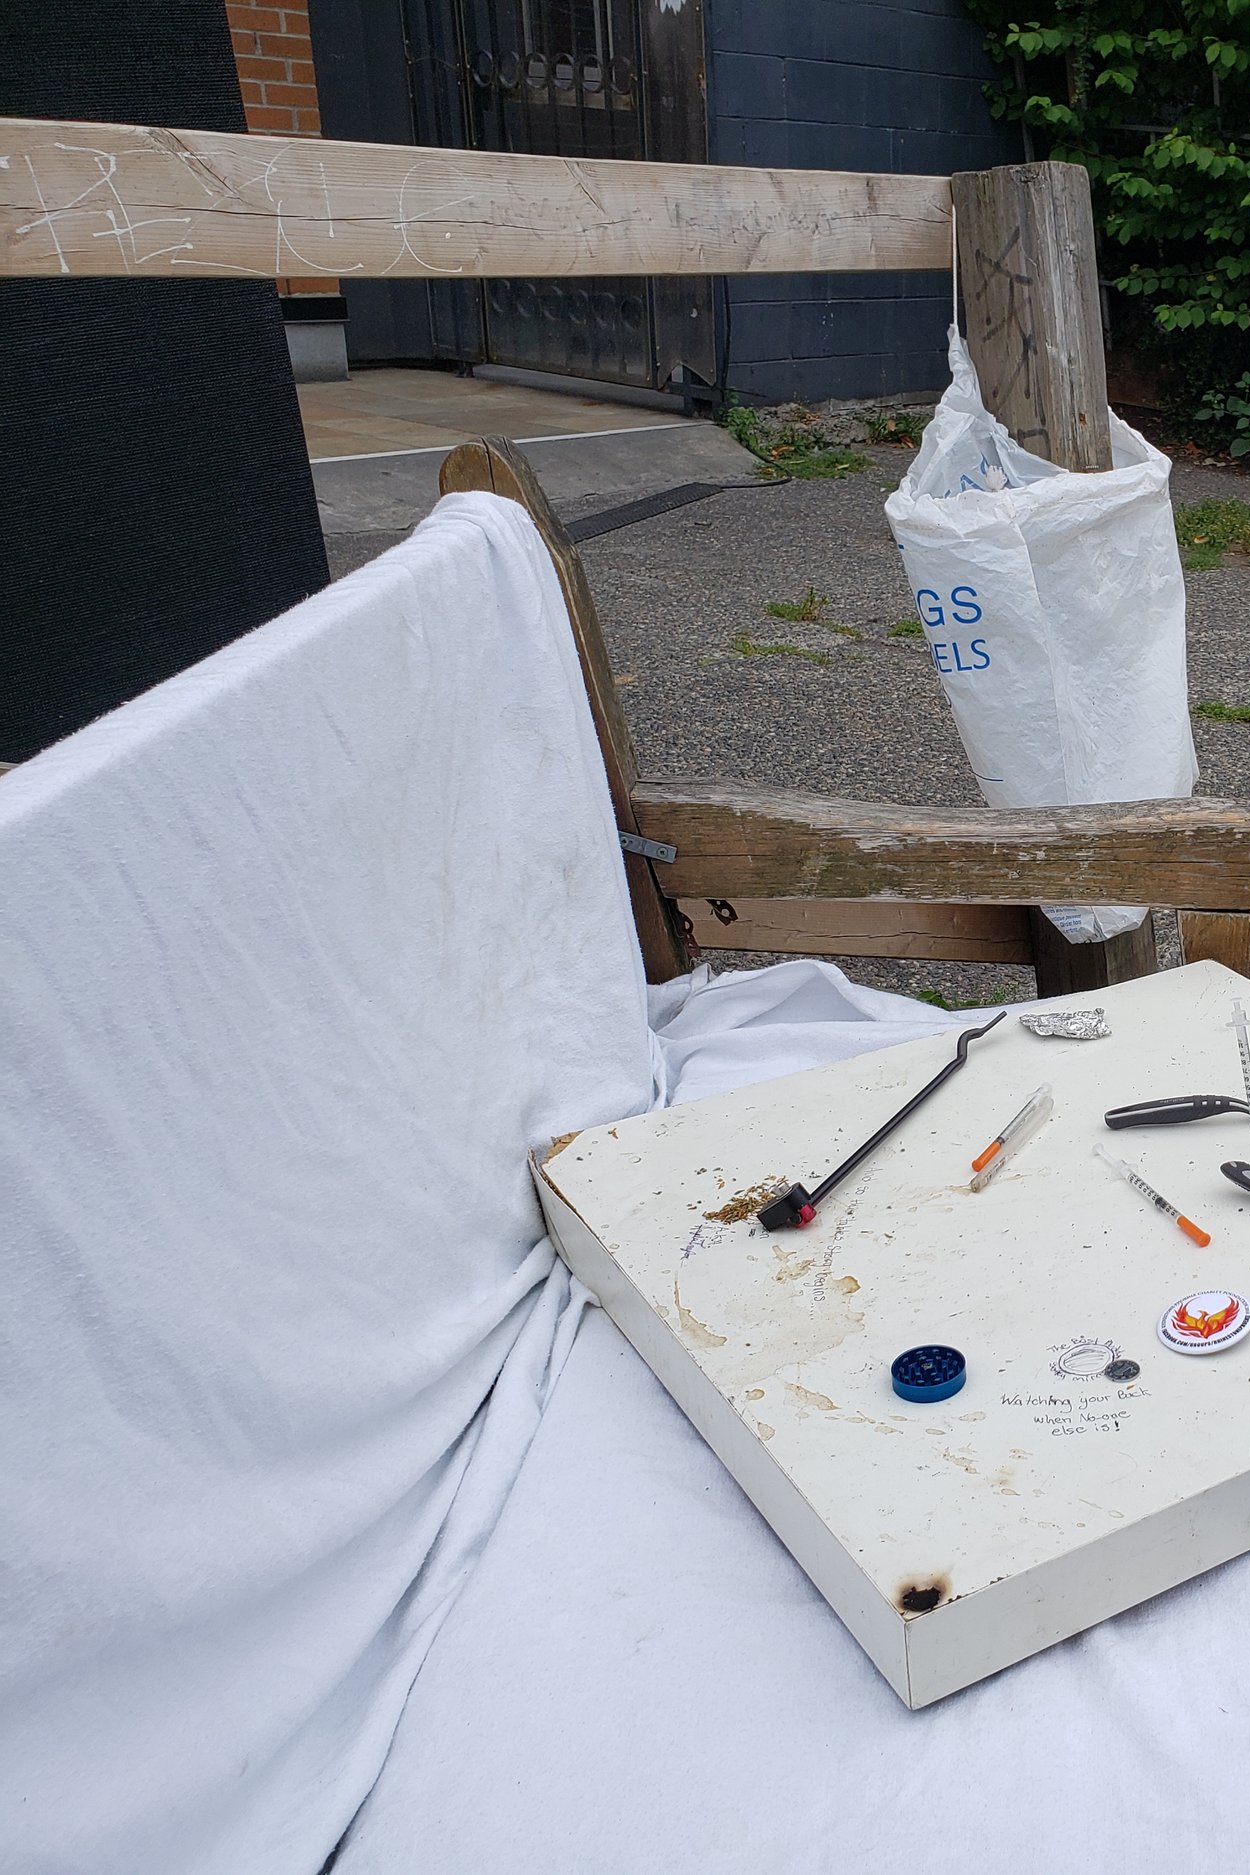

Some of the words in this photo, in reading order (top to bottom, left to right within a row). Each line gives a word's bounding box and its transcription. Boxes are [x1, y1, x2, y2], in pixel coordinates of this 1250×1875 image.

[930, 638, 991, 674] ELS
[1078, 1395, 1111, 1410] your
[1033, 1414, 1072, 1424] when
[1051, 1425, 1088, 1436] else
